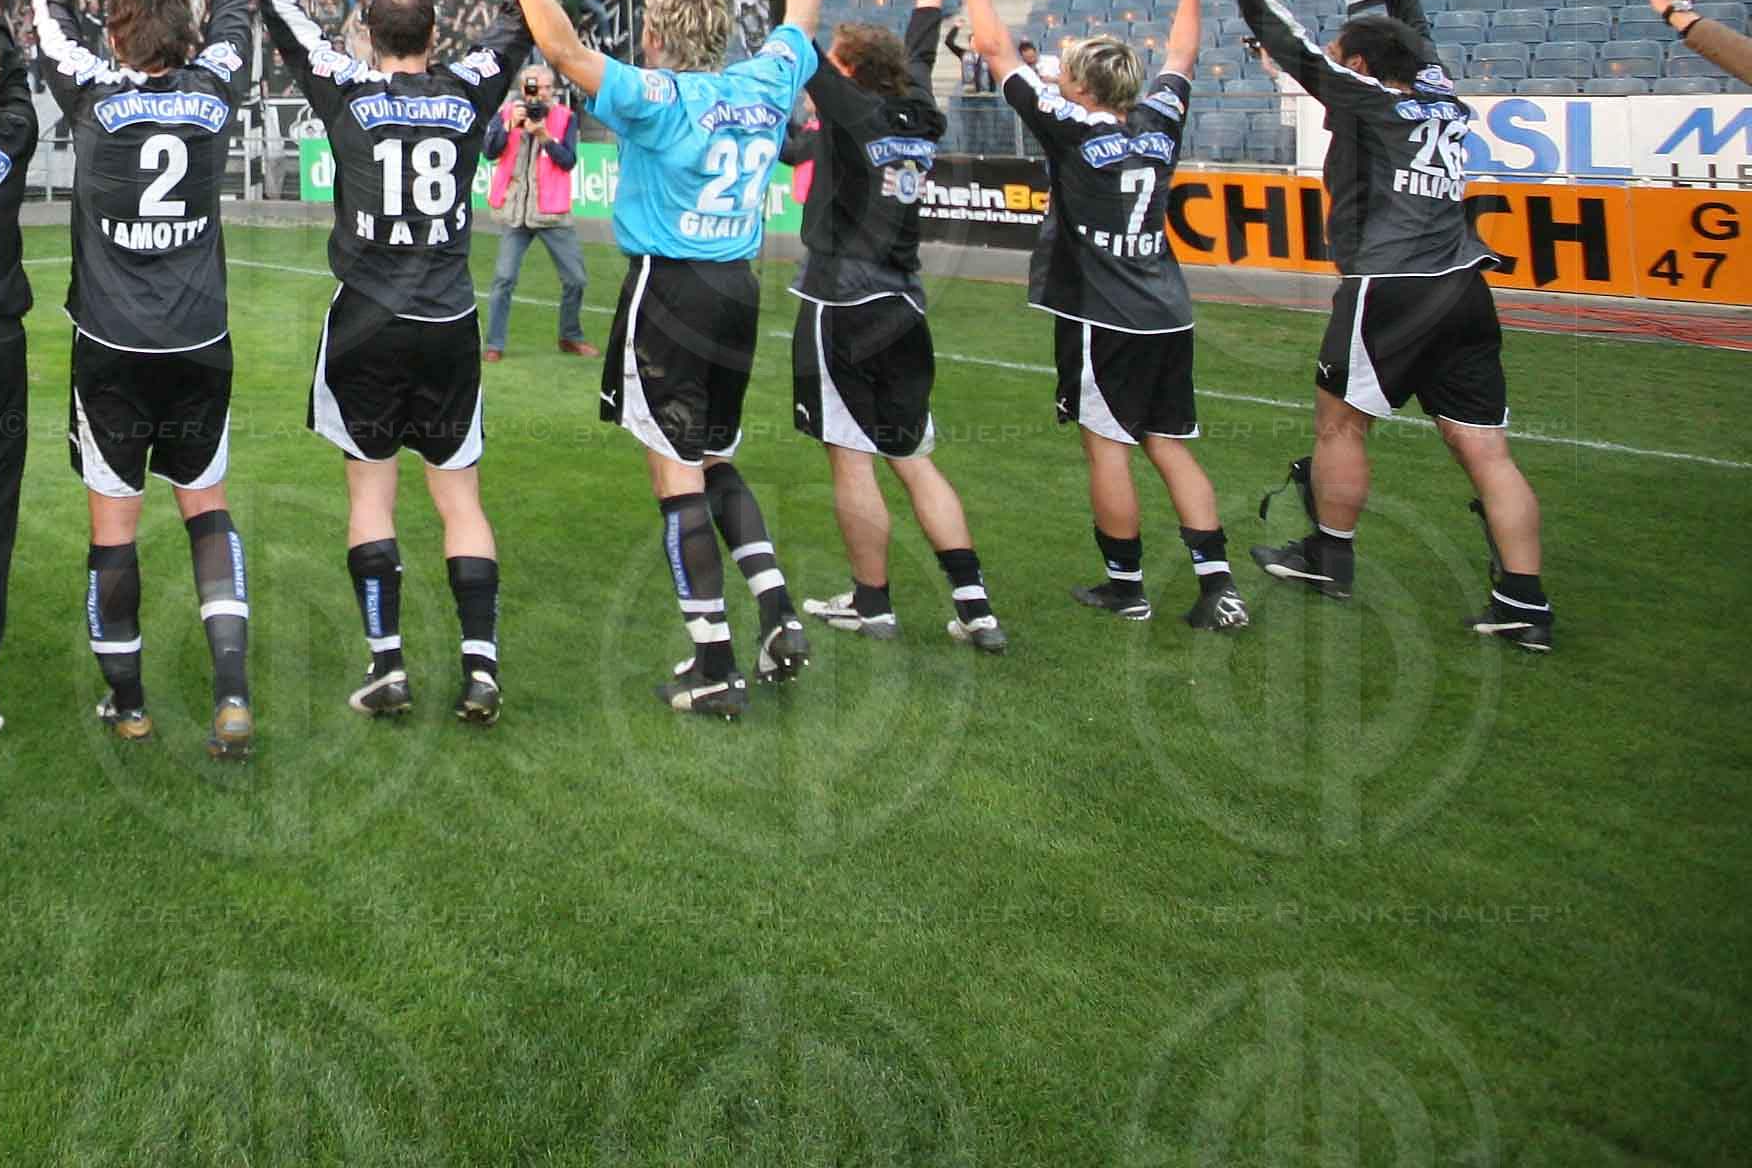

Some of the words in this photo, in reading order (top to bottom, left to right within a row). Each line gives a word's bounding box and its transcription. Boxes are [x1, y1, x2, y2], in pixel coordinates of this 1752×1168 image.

[104, 94, 225, 125] PUNTIGAMER
[137, 133, 188, 217] 2
[372, 136, 458, 216] 18
[1120, 167, 1157, 234] 7
[1691, 202, 1741, 241] G
[356, 203, 468, 246] HAAS
[1648, 249, 1728, 289] 47
